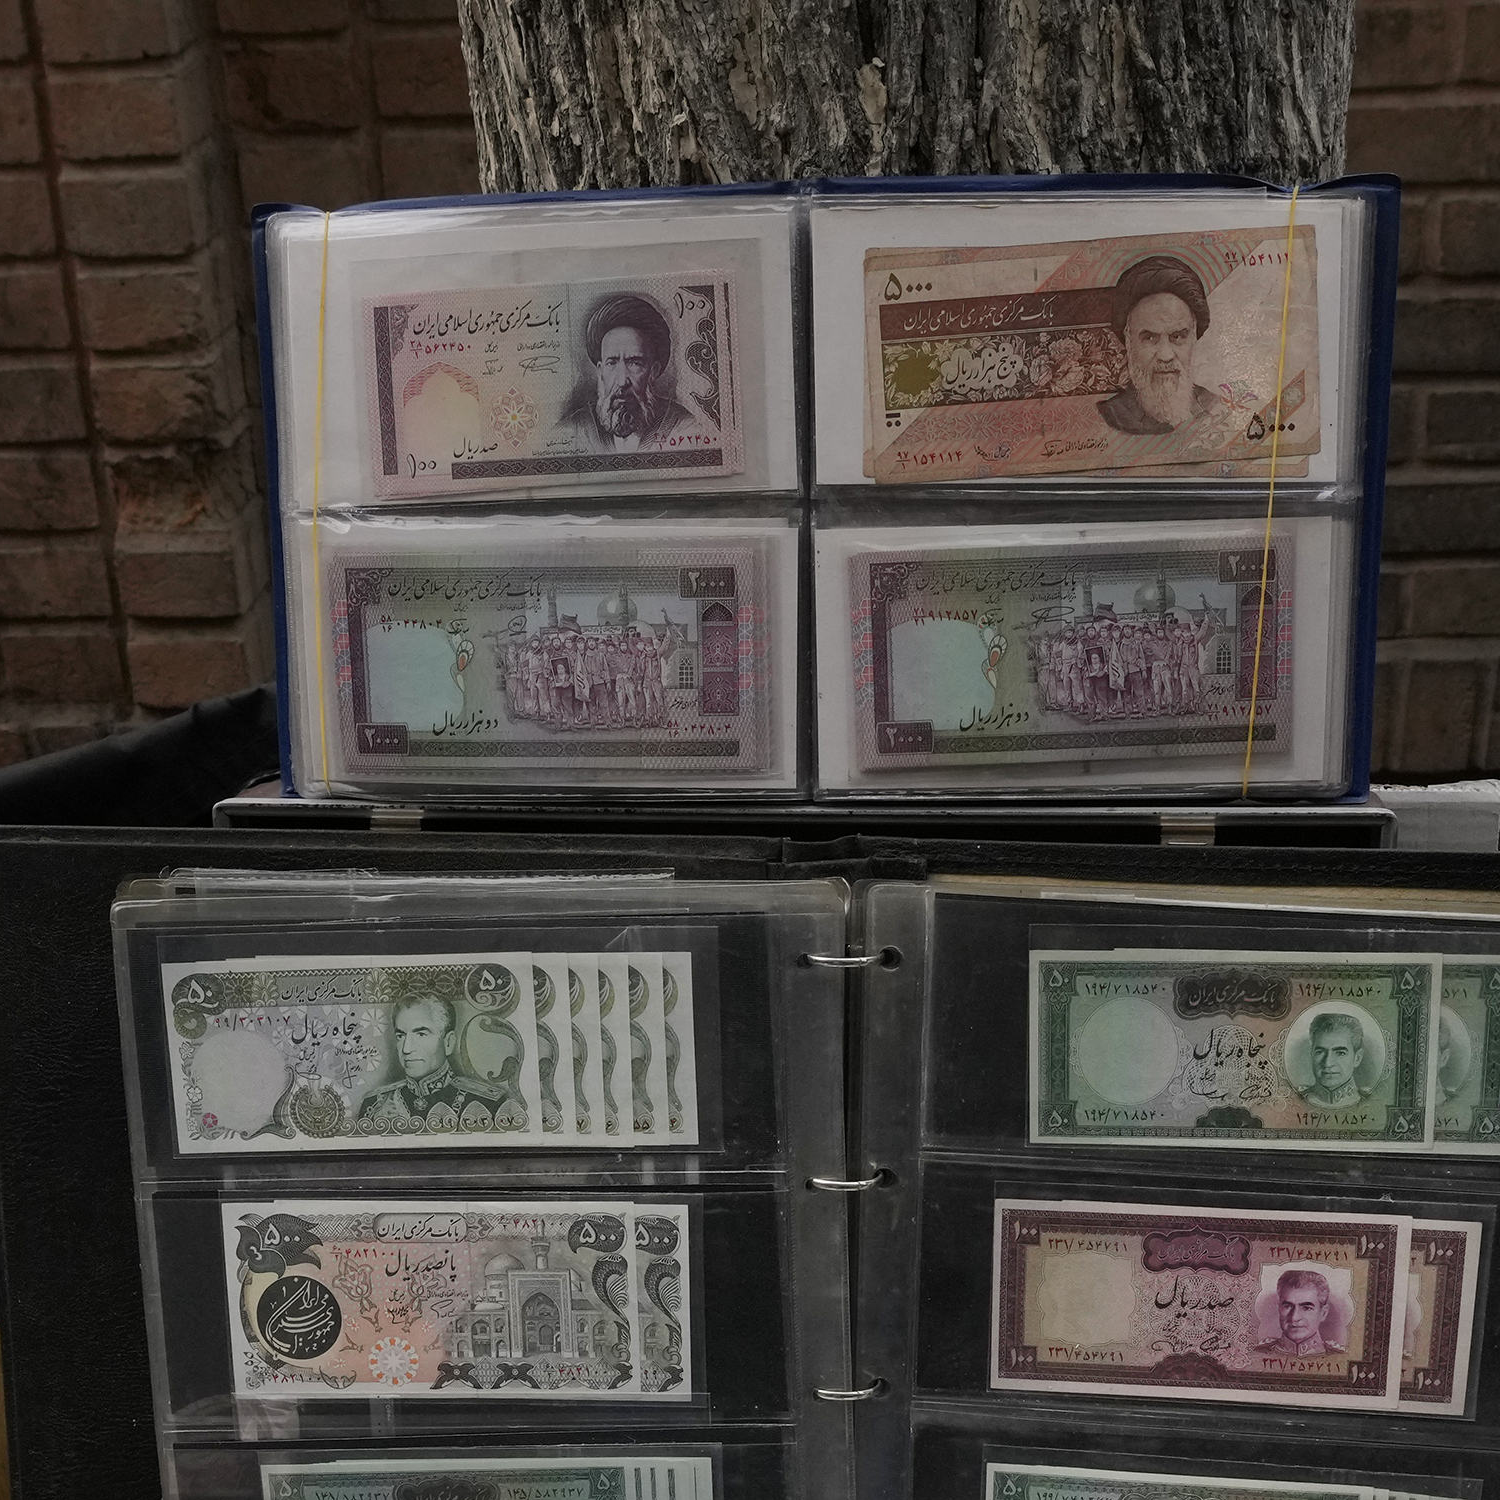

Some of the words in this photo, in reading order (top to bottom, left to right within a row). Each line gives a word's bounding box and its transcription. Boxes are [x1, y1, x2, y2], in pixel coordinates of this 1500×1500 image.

[883, 271, 934, 302] ۵۰۰۰
[500, 300, 532, 333] مرکزی
[527, 302, 564, 333] بانک
[674, 290, 706, 319] ۱۰۰
[929, 303, 964, 332] اسلامی
[960, 305, 997, 329] جمهوری
[993, 296, 1023, 327] مرکزی
[1020, 294, 1057, 327] بانک
[413, 312, 440, 339] ایران
[438, 308, 472, 337] اسلامی
[468, 309, 503, 335] جمهوری
[903, 308, 931, 335] ایران
[945, 355, 973, 388] ریال
[973, 352, 996, 383] هزار
[996, 347, 1017, 379] پنج
[1246, 412, 1296, 440] ۵۰۰۰
[453, 436, 477, 461] ریال
[476, 440, 499, 456] صد
[407, 453, 437, 479] ۱۰۰
[388, 576, 415, 601] ایران
[413, 576, 449, 600] اسلامی
[445, 578, 482, 601] جمهوری
[478, 569, 512, 600] مرکزی
[507, 573, 545, 602] بانک
[687, 570, 726, 590] ۲۰۰۰
[433, 710, 463, 736] ریال
[463, 709, 484, 736] هزار
[485, 718, 498, 730] دو
[959, 705, 991, 732] ریال
[991, 703, 1014, 730] هزار
[1015, 711, 1030, 723] دو
[365, 731, 400, 749] ۲۰۰۰
[887, 726, 925, 747] ۲۰۰۰
[186, 978, 213, 1000] ۵۰
[307, 976, 339, 1002] مرکزی
[334, 977, 365, 1003] بانک
[479, 970, 502, 991] ۵۰
[1047, 968, 1070, 988] ۵۰
[1399, 969, 1423, 991] ۵۰
[281, 983, 308, 1003] ایران
[291, 1014, 329, 1046] ریال
[332, 1012, 362, 1042] پنجاه
[1193, 1028, 1235, 1067] ریال
[1236, 1031, 1268, 1070] پنجاه
[263, 1223, 301, 1247] ۵۰۰
[377, 1221, 407, 1241] ایران
[407, 1214, 434, 1239] مرکزی
[430, 1215, 459, 1239] بانک
[581, 1221, 625, 1244] ۵۰۰
[1012, 1220, 1039, 1241] ۱۰۰
[1358, 1234, 1386, 1255] ۱۰۰
[384, 1248, 421, 1281] ریال
[422, 1249, 456, 1282] پانصد
[1154, 1275, 1201, 1319] ریال
[1202, 1297, 1234, 1311] صد
[279, 1479, 297, 1496] ۵۰
[597, 1474, 618, 1491] ۵۰
[1003, 1478, 1023, 1497] ۵۰
